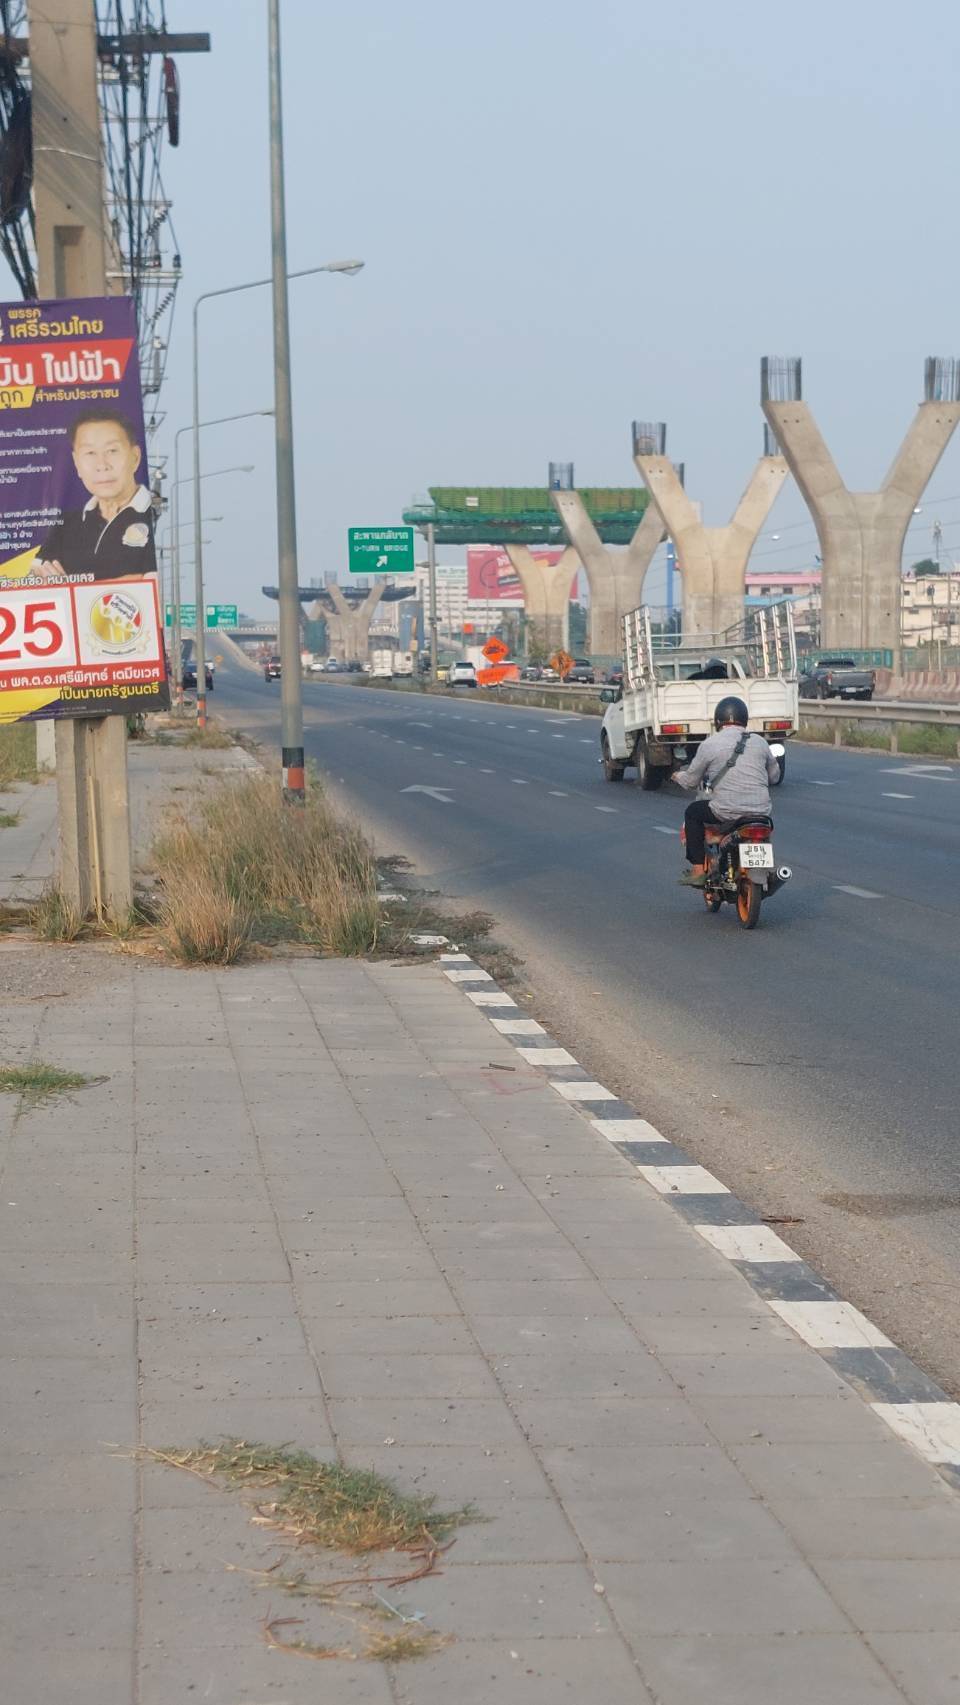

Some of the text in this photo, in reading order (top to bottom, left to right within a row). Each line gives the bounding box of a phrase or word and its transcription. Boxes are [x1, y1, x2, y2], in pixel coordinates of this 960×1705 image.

[8, 308, 41, 319] พรรค
[10, 316, 104, 339] เสรีรวมไทย
[41, 350, 121, 385] ไฟฟ้า
[35, 388, 119, 402] สำหรับประชาชน
[47, 573, 95, 585] หมายเลข
[60, 682, 160, 701] เป็นนายกรัฐมนตรี
